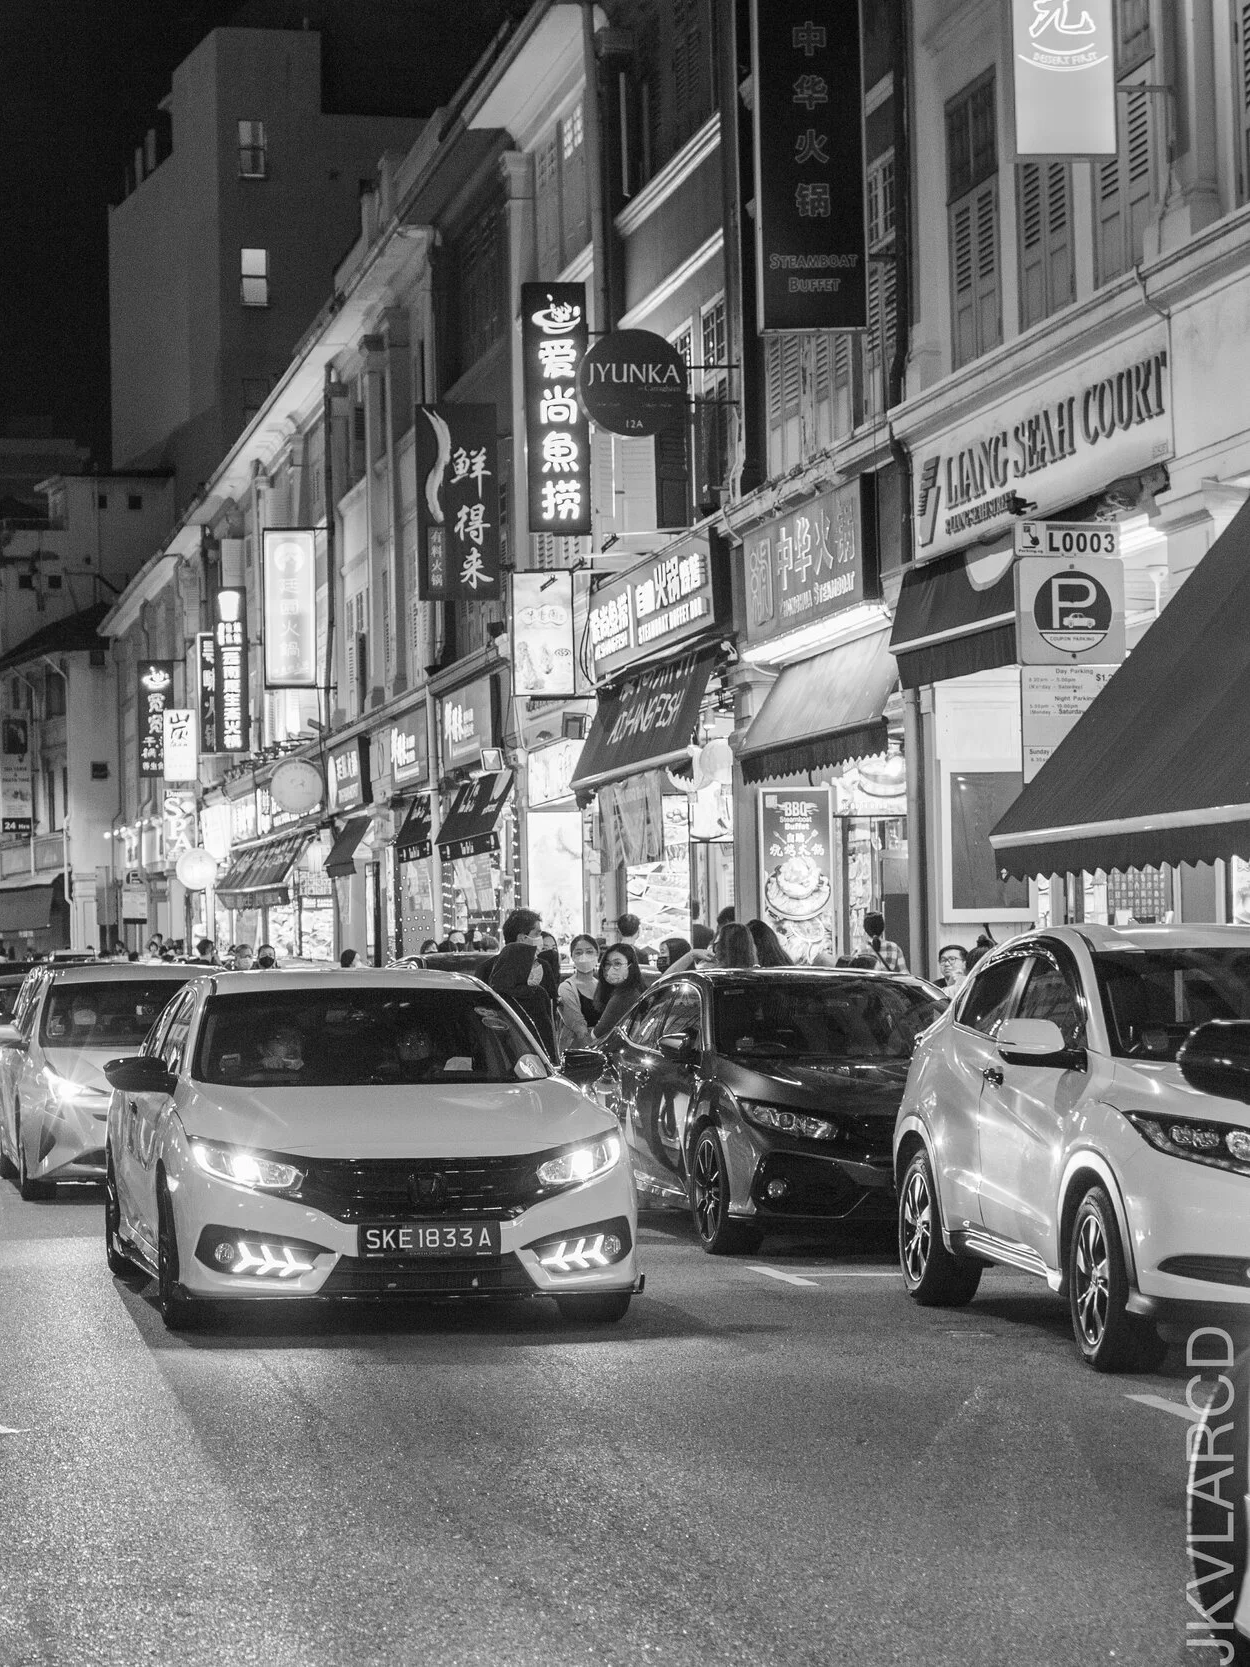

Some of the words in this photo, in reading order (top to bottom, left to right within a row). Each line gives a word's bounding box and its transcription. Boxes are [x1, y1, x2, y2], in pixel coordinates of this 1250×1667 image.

[792, 20, 831, 217] 中华火锅
[588, 363, 681, 386] JYUNKA
[625, 420, 643, 428] 12A
[945, 431, 1009, 510] LIANG
[1013, 396, 1077, 478] SEAH
[1083, 351, 1167, 445] COURT
[1048, 532, 1116, 553] L0003
[1055, 668, 1067, 676] Day
[1071, 667, 1093, 675] Parking
[1054, 695, 1070, 703] Night
[784, 801, 807, 817] BBQ
[779, 815, 813, 823] Steamboat
[4, 821, 16, 830] 24
[784, 822, 810, 830] Buffet
[366, 1227, 492, 1249] SKE1833A
